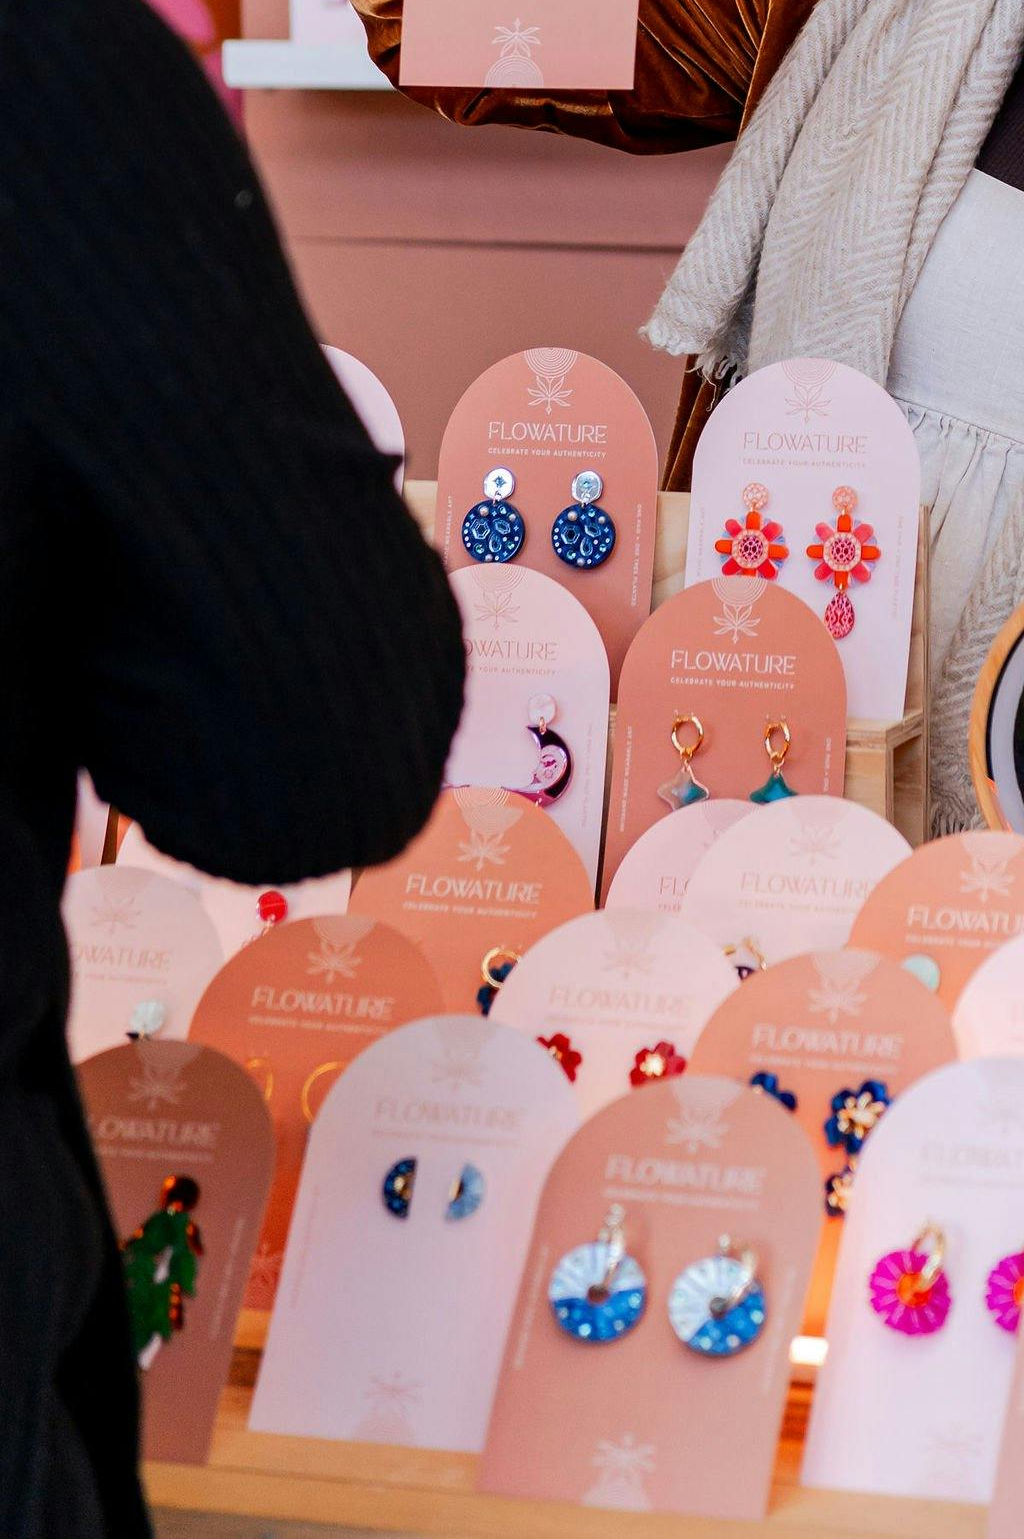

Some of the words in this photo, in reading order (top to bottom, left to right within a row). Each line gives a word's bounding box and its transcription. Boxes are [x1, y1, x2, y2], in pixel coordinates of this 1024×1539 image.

[488, 421, 608, 444] FLOWATURE
[743, 431, 869, 454] FLOWATURE
[488, 447, 529, 455] CELEBRATE
[531, 449, 551, 457] YOUR
[553, 450, 607, 459] AUTHENTICITY
[464, 638, 558, 661] OWATURE
[670, 649, 797, 675] FLOWATURE
[670, 677, 713, 686] CELEBRATE
[716, 679, 736, 687] YOUR
[739, 681, 795, 691] AUTHENTICITY
[405, 873, 542, 904] FLOWATURE
[76, 944, 174, 973] WATURE
[251, 985, 395, 1020] FLOWATURE
[752, 1022, 904, 1060] FLOWATURE
[97, 1118, 218, 1149] OWATURE
